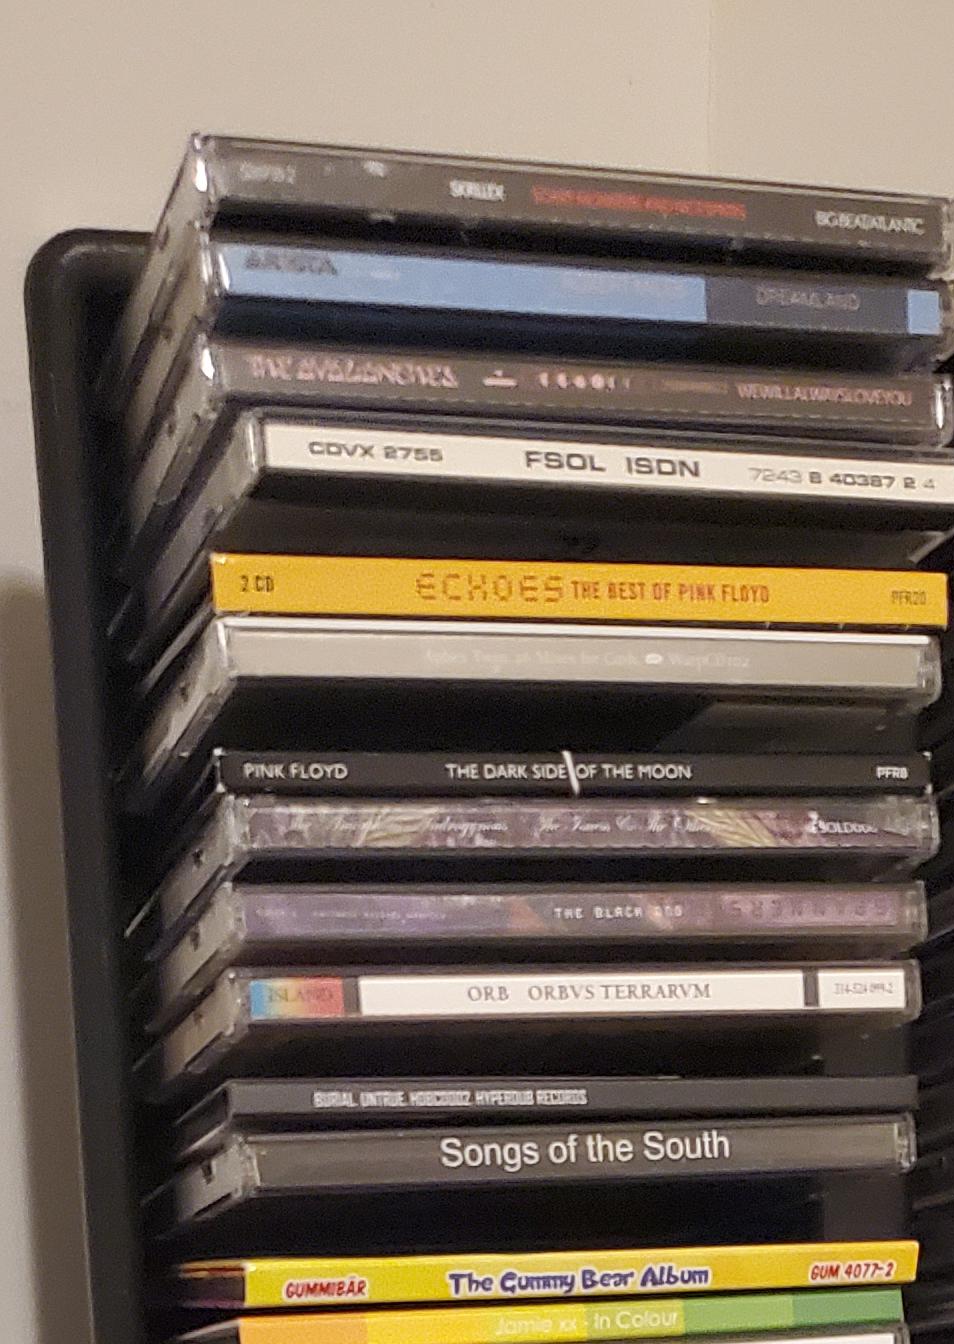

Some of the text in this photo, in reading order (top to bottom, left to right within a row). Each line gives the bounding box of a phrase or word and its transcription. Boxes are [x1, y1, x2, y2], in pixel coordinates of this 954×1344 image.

[308, 441, 444, 462] CDVX 2755
[525, 451, 700, 478] FSOL ISDN
[415, 573, 770, 603] ECHOES THE BEST OF PINK FLOYD
[243, 763, 348, 780] PINK FLOYD
[445, 763, 692, 781] THE DARK SIDE OF THE MOON
[467, 983, 711, 1002] ORB ORBVS TERRARVM
[440, 1130, 731, 1172] Songs of the South
[449, 1265, 710, 1294] The Gummy Bear Album
[811, 1261, 896, 1281] GUM 4077-2
[593, 1308, 679, 1331] In Colour
